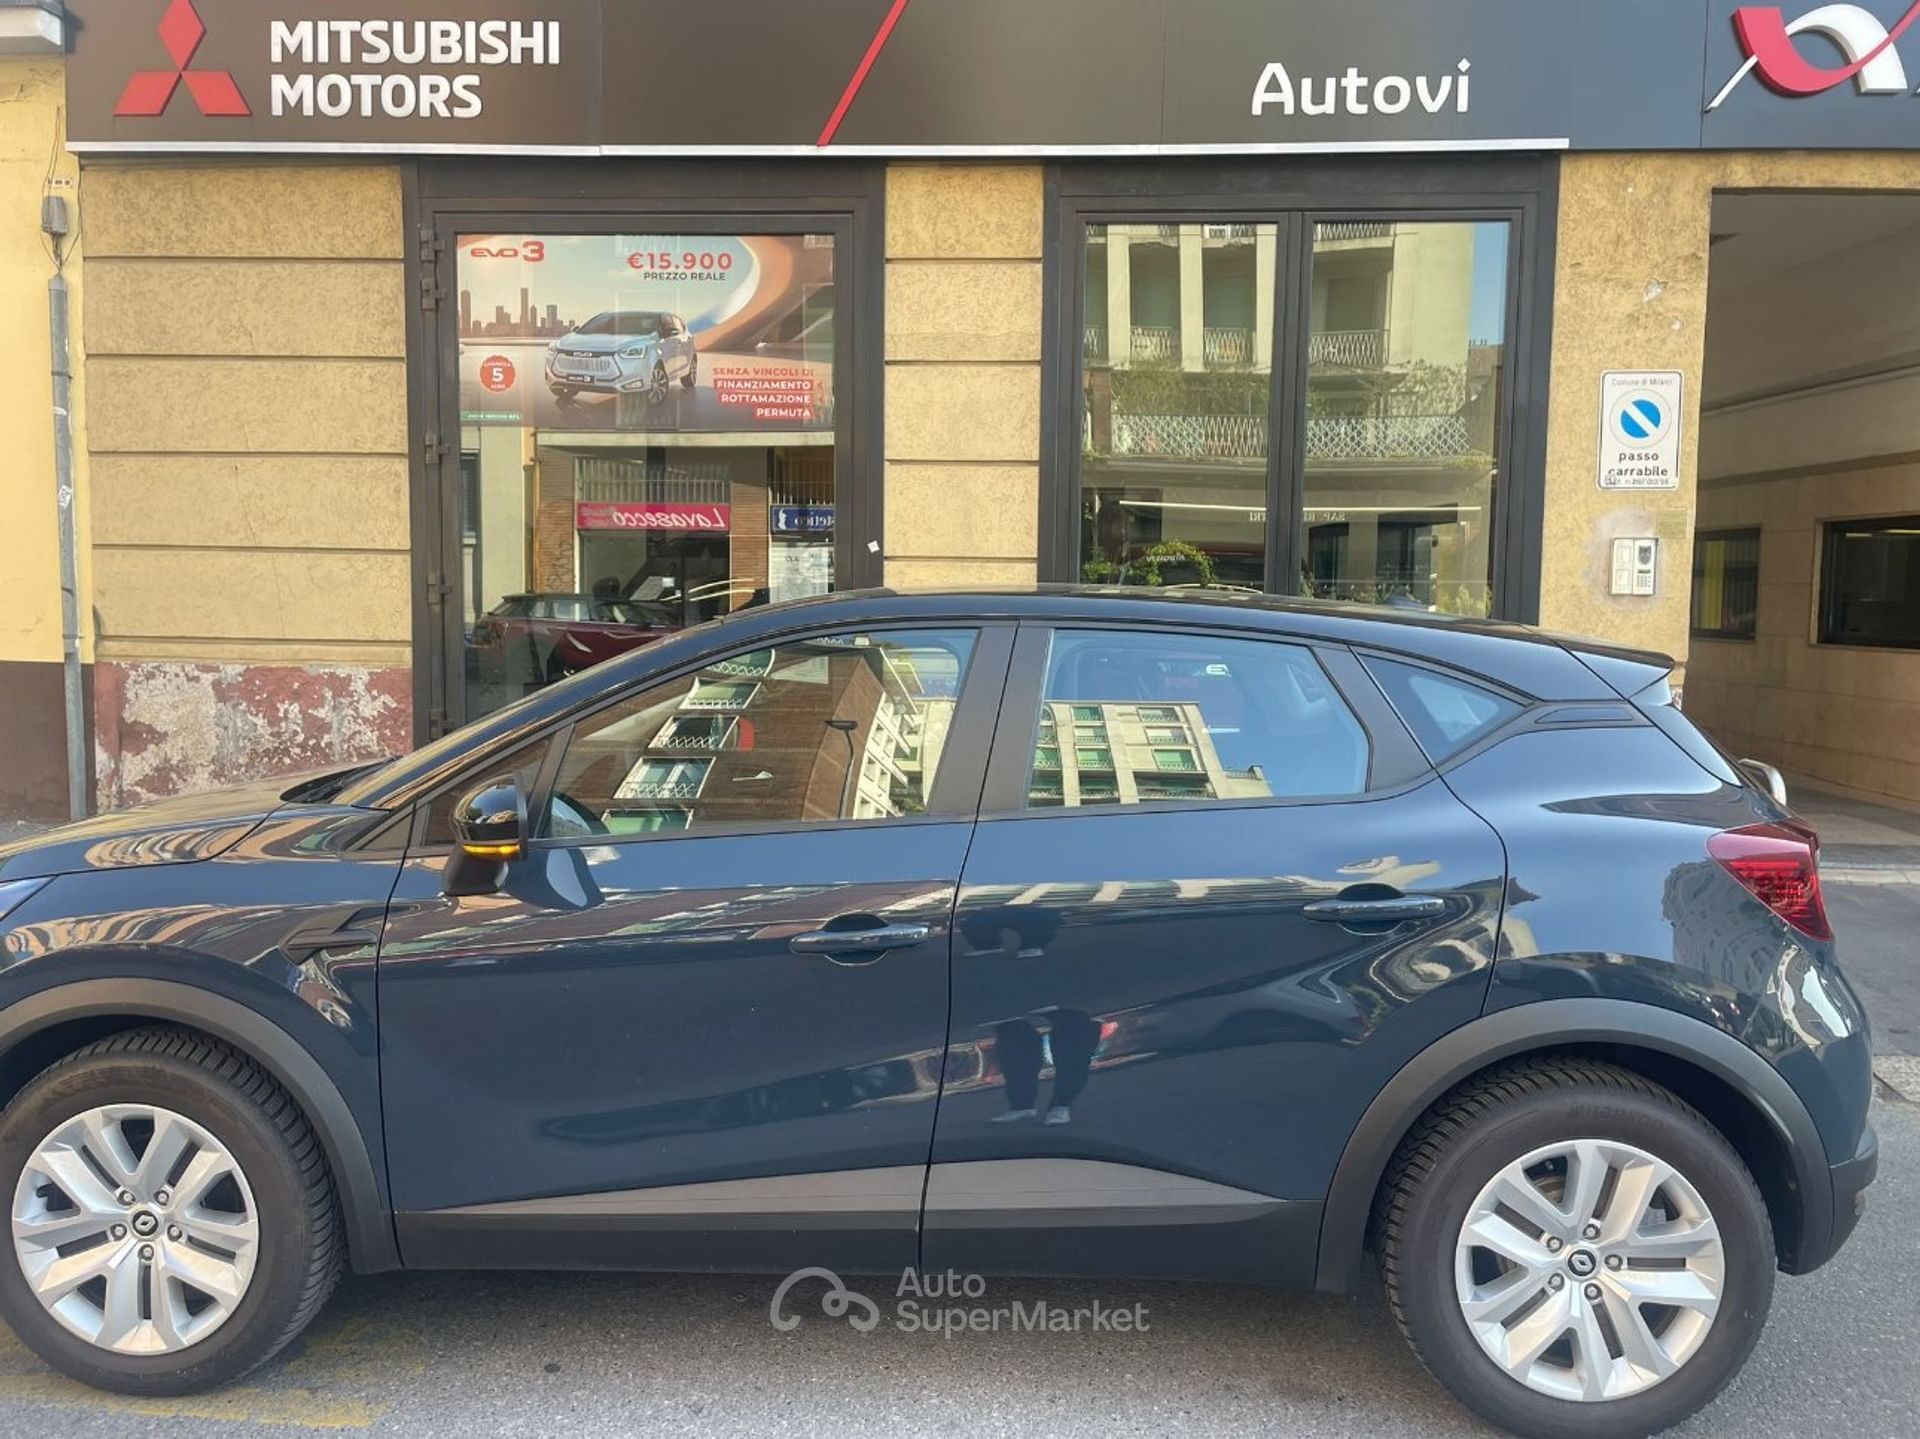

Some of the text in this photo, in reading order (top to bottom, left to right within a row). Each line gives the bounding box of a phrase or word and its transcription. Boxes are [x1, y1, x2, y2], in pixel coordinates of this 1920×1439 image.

[270, 20, 561, 65] MITSUBISHI
[1251, 58, 1471, 116] Autovi
[270, 74, 483, 118] MOTORS
[522, 240, 545, 263] 3
[627, 252, 733, 271] €15.900
[643, 271, 726, 282] PREZZO REALE
[491, 367, 505, 382] 5
[712, 367, 750, 376] SENZA
[753, 367, 798, 377] VINCOLI
[717, 380, 812, 390] FINANZIAMENTO
[721, 393, 811, 403] ROTTAMAZIONE
[756, 407, 811, 417] PERMUTA
[1618, 452, 1659, 464] passo
[1608, 465, 1668, 477] carrabile
